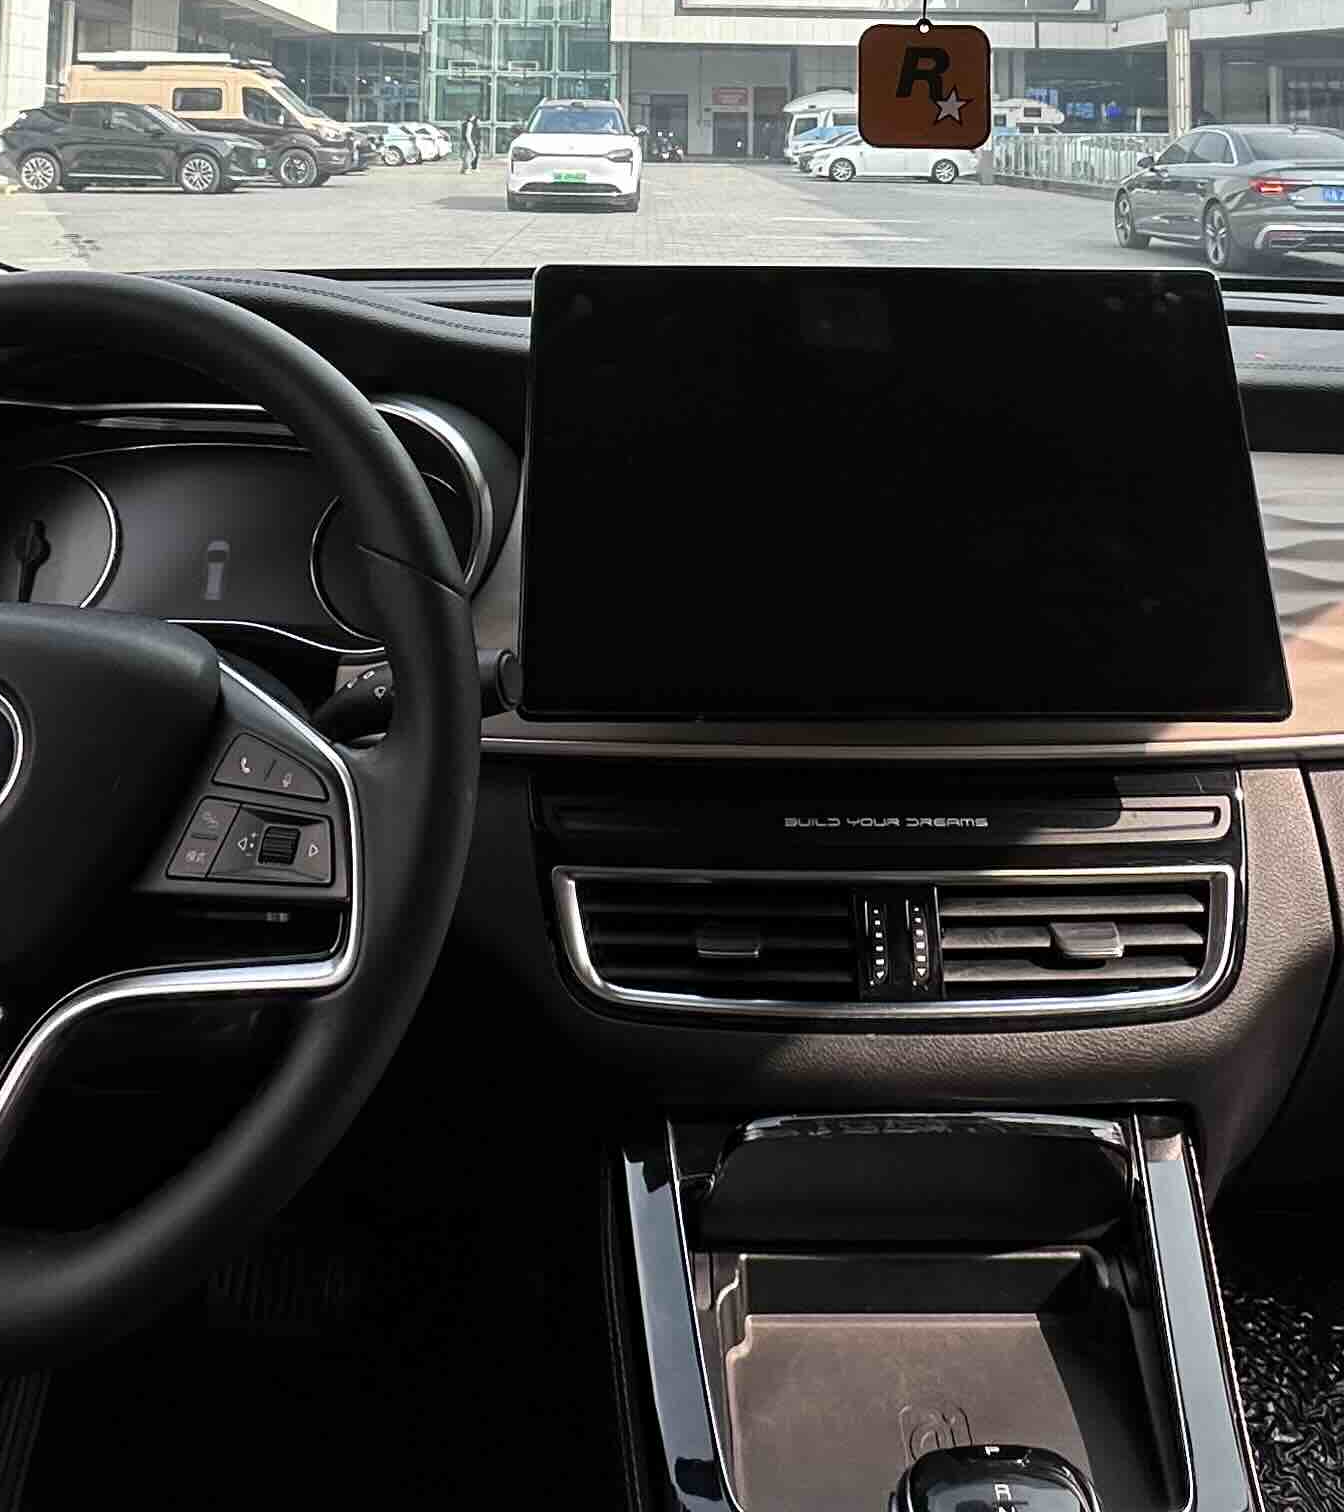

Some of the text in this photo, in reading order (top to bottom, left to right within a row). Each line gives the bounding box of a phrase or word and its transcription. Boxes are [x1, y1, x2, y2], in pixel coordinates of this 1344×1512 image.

[895, 45, 952, 105] R
[783, 816, 990, 828] BUILD YOUR DREAMS
